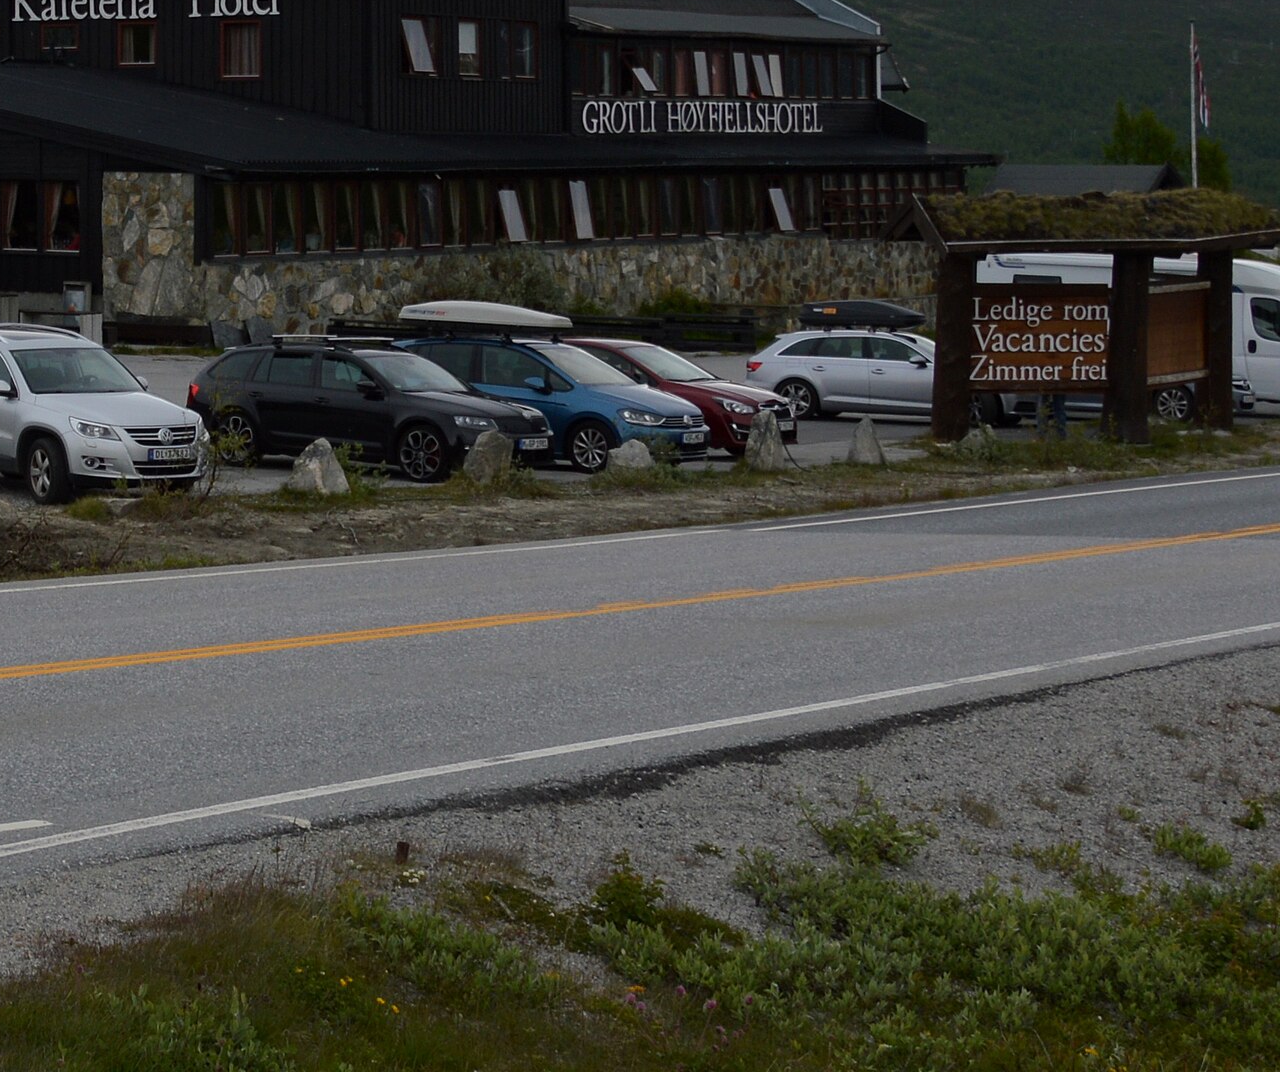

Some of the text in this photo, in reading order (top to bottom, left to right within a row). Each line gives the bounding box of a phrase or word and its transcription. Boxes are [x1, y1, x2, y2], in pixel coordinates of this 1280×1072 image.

[582, 100, 823, 134] GROTLI HØYFJELLSHOTEL
[972, 296, 1109, 327] Ledige rom
[973, 324, 1105, 353] Vacancies
[969, 354, 1107, 382] Zimmer frei
